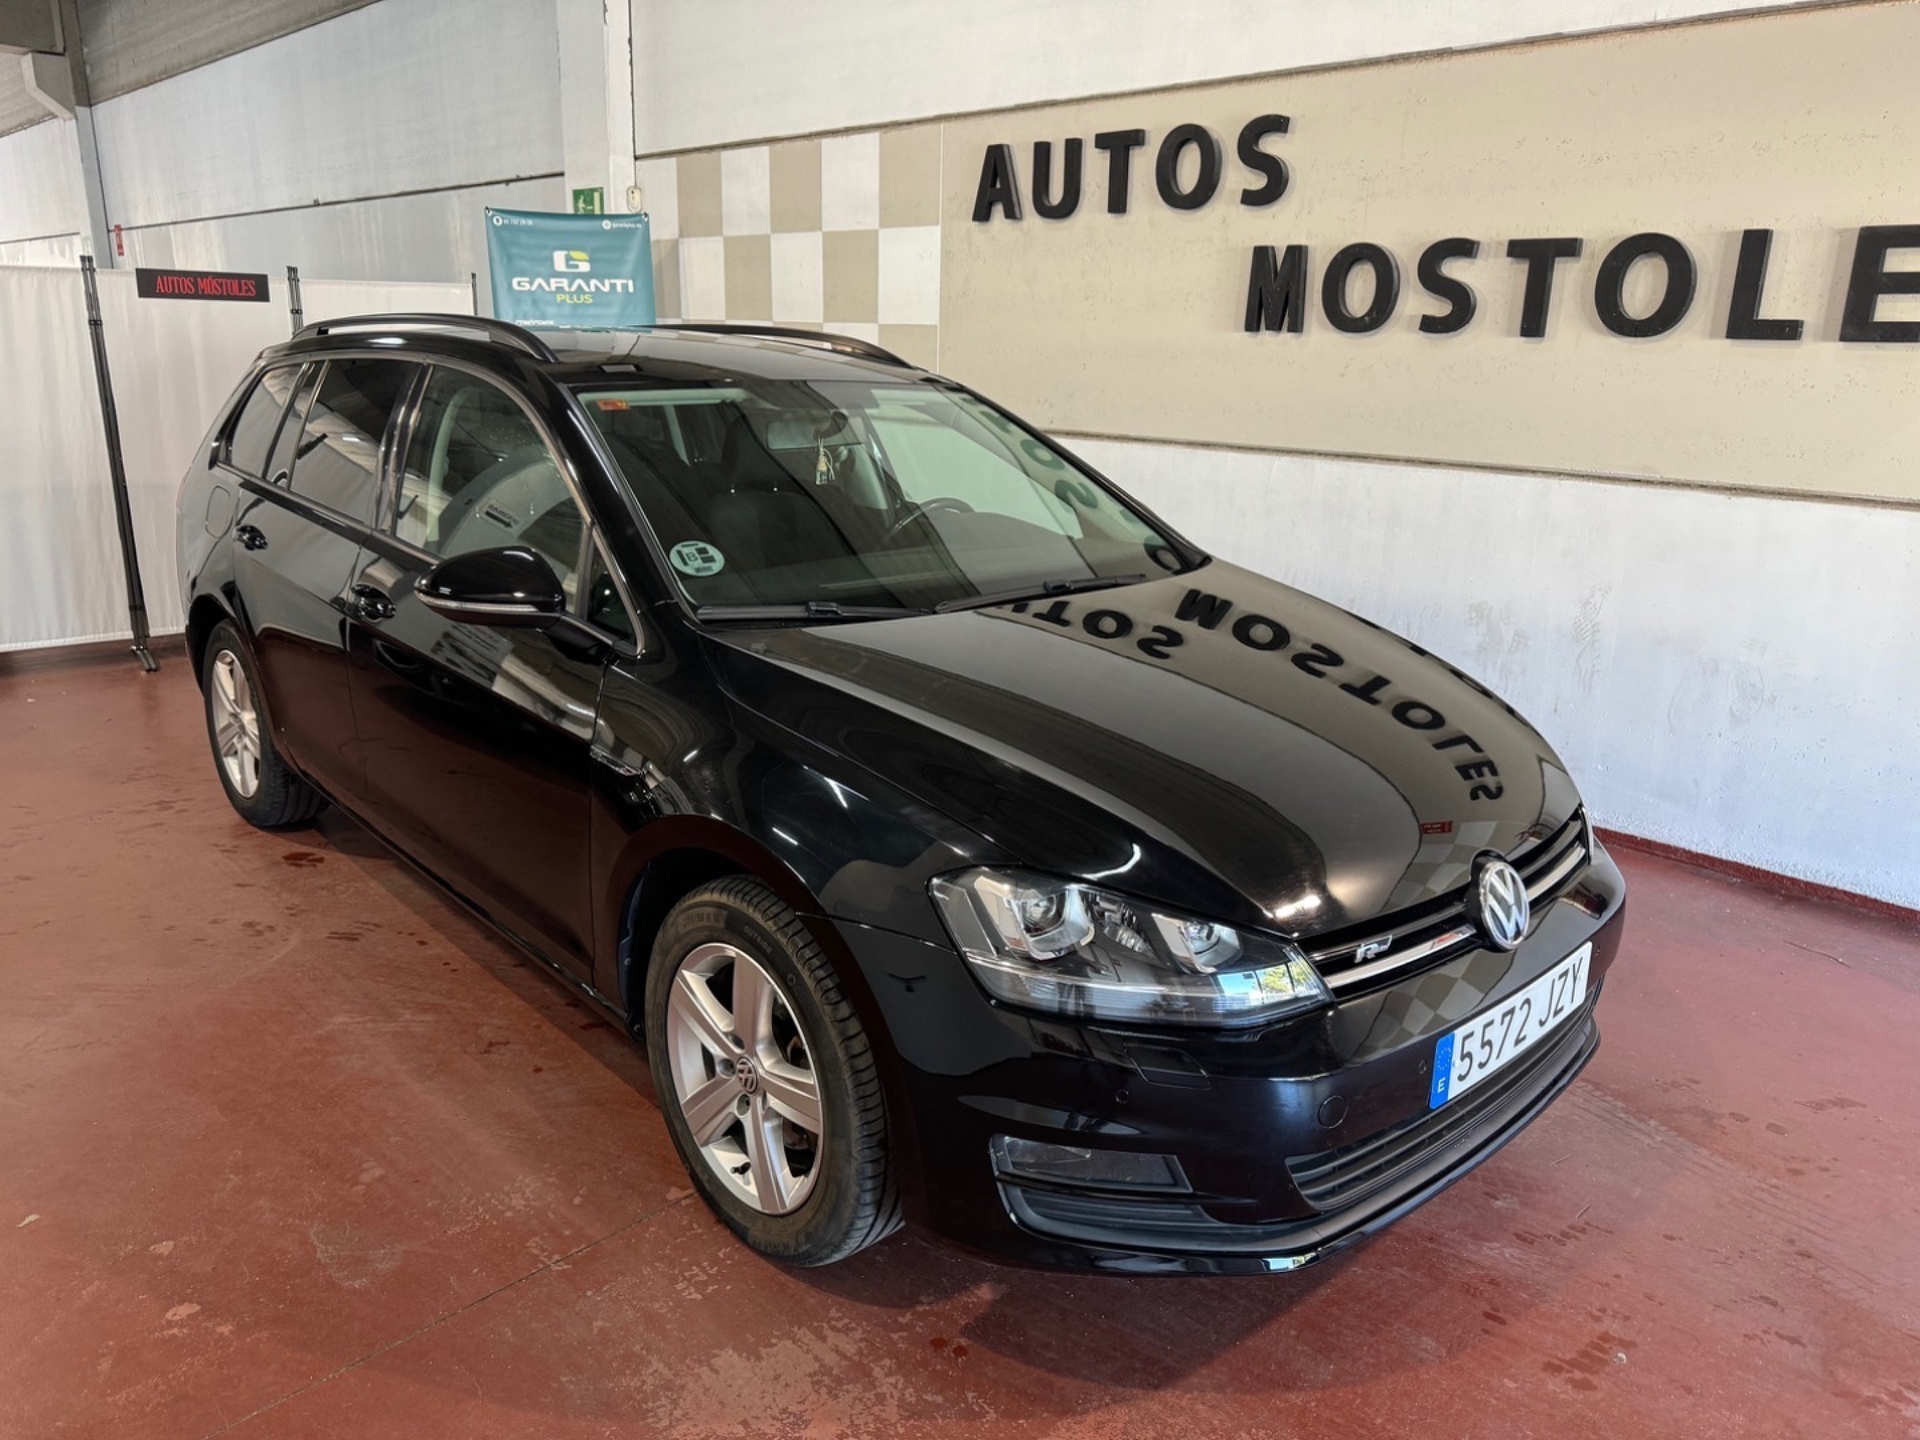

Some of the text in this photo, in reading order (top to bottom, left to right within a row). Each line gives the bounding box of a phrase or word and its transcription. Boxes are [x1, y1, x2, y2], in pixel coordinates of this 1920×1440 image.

[972, 114, 1291, 223] AUTOS
[156, 275, 257, 297] AUTOS MÓSTOLES
[511, 277, 634, 293] GARANTI
[556, 294, 593, 304] PLUS
[1437, 956, 1584, 1093] E 5572 JZY
